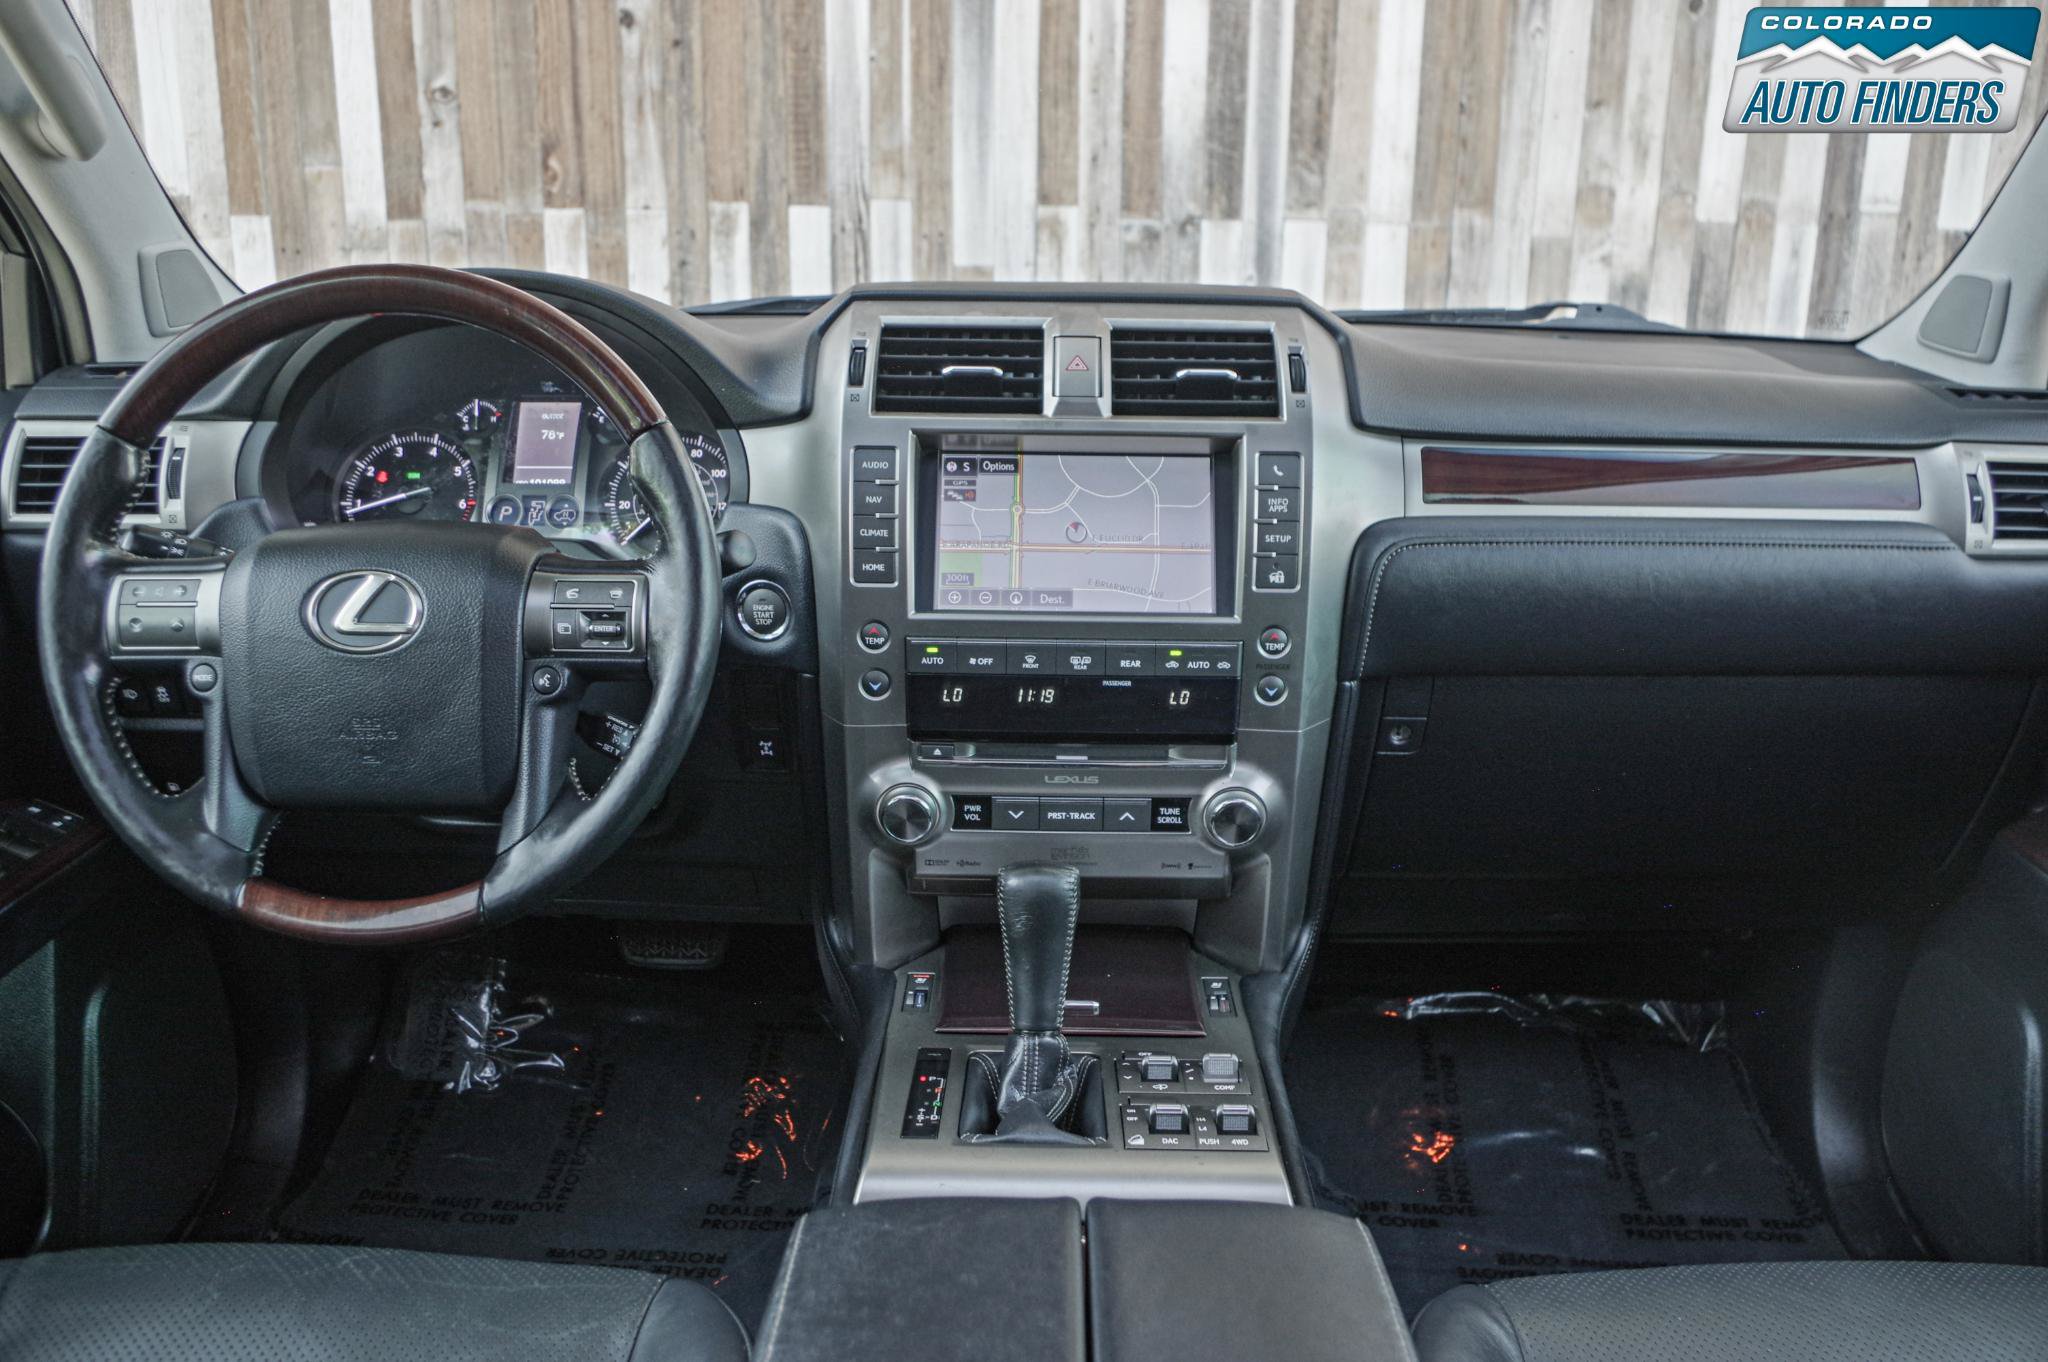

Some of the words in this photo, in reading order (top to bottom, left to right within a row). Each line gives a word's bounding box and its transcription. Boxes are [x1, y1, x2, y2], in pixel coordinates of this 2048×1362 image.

[394, 447, 403, 457] 3
[428, 447, 438, 457] 4
[691, 449, 703, 458] 80
[861, 461, 889, 469] AUDIO
[982, 461, 1015, 473] Options
[366, 466, 375, 477] 2
[453, 466, 462, 477] 5
[711, 469, 726, 478] 100
[865, 495, 882, 504] NAV
[1268, 498, 1289, 506] INFO
[458, 499, 467, 510] 6
[618, 501, 631, 509] 20
[1268, 505, 1288, 513] APPS
[860, 528, 889, 537] CLIMATE
[1265, 534, 1292, 543] SETUP
[862, 563, 885, 572] HOME
[1040, 593, 1065, 604] Dest.
[752, 611, 780, 619] START
[755, 618, 773, 626] STOP
[864, 637, 885, 645] TEMP
[1265, 642, 1285, 651] TEMP
[921, 656, 944, 665] AUTO
[978, 657, 994, 665] OFF
[1120, 659, 1141, 668] REAR
[1187, 661, 1210, 669] AUTO
[1017, 688, 1055, 704] 11:19
[339, 729, 399, 740] AIRBAG
[1044, 775, 1100, 784] LEXUS
[964, 804, 982, 812] PWR
[1160, 807, 1180, 816] TUNE
[964, 813, 981, 821] VOL
[1158, 816, 1182, 824] SCROLL
[1162, 1137, 1179, 1145] DAC
[1199, 1137, 1220, 1145] PUSH
[1231, 1138, 1249, 1146] 4WD
[357, 1187, 422, 1204] DEALER
[431, 1195, 484, 1210] MUST
[489, 1199, 567, 1213] REMOVE
[347, 1203, 452, 1222] PROTECTIVE
[458, 1211, 519, 1225] COVER
[706, 1203, 774, 1217] DEALER
[1400, 1202, 1479, 1217] REMOVE
[1378, 1215, 1439, 1228] COVER
[1620, 1213, 1686, 1226] DEALER
[1699, 1215, 1749, 1228] MUST
[1624, 1228, 1737, 1242] PROTECTIVE
[1742, 1230, 1806, 1243] COVER
[544, 1247, 608, 1260] COVER
[614, 1249, 728, 1265] PROTECTIVE
[1496, 1253, 1560, 1266] COVER
